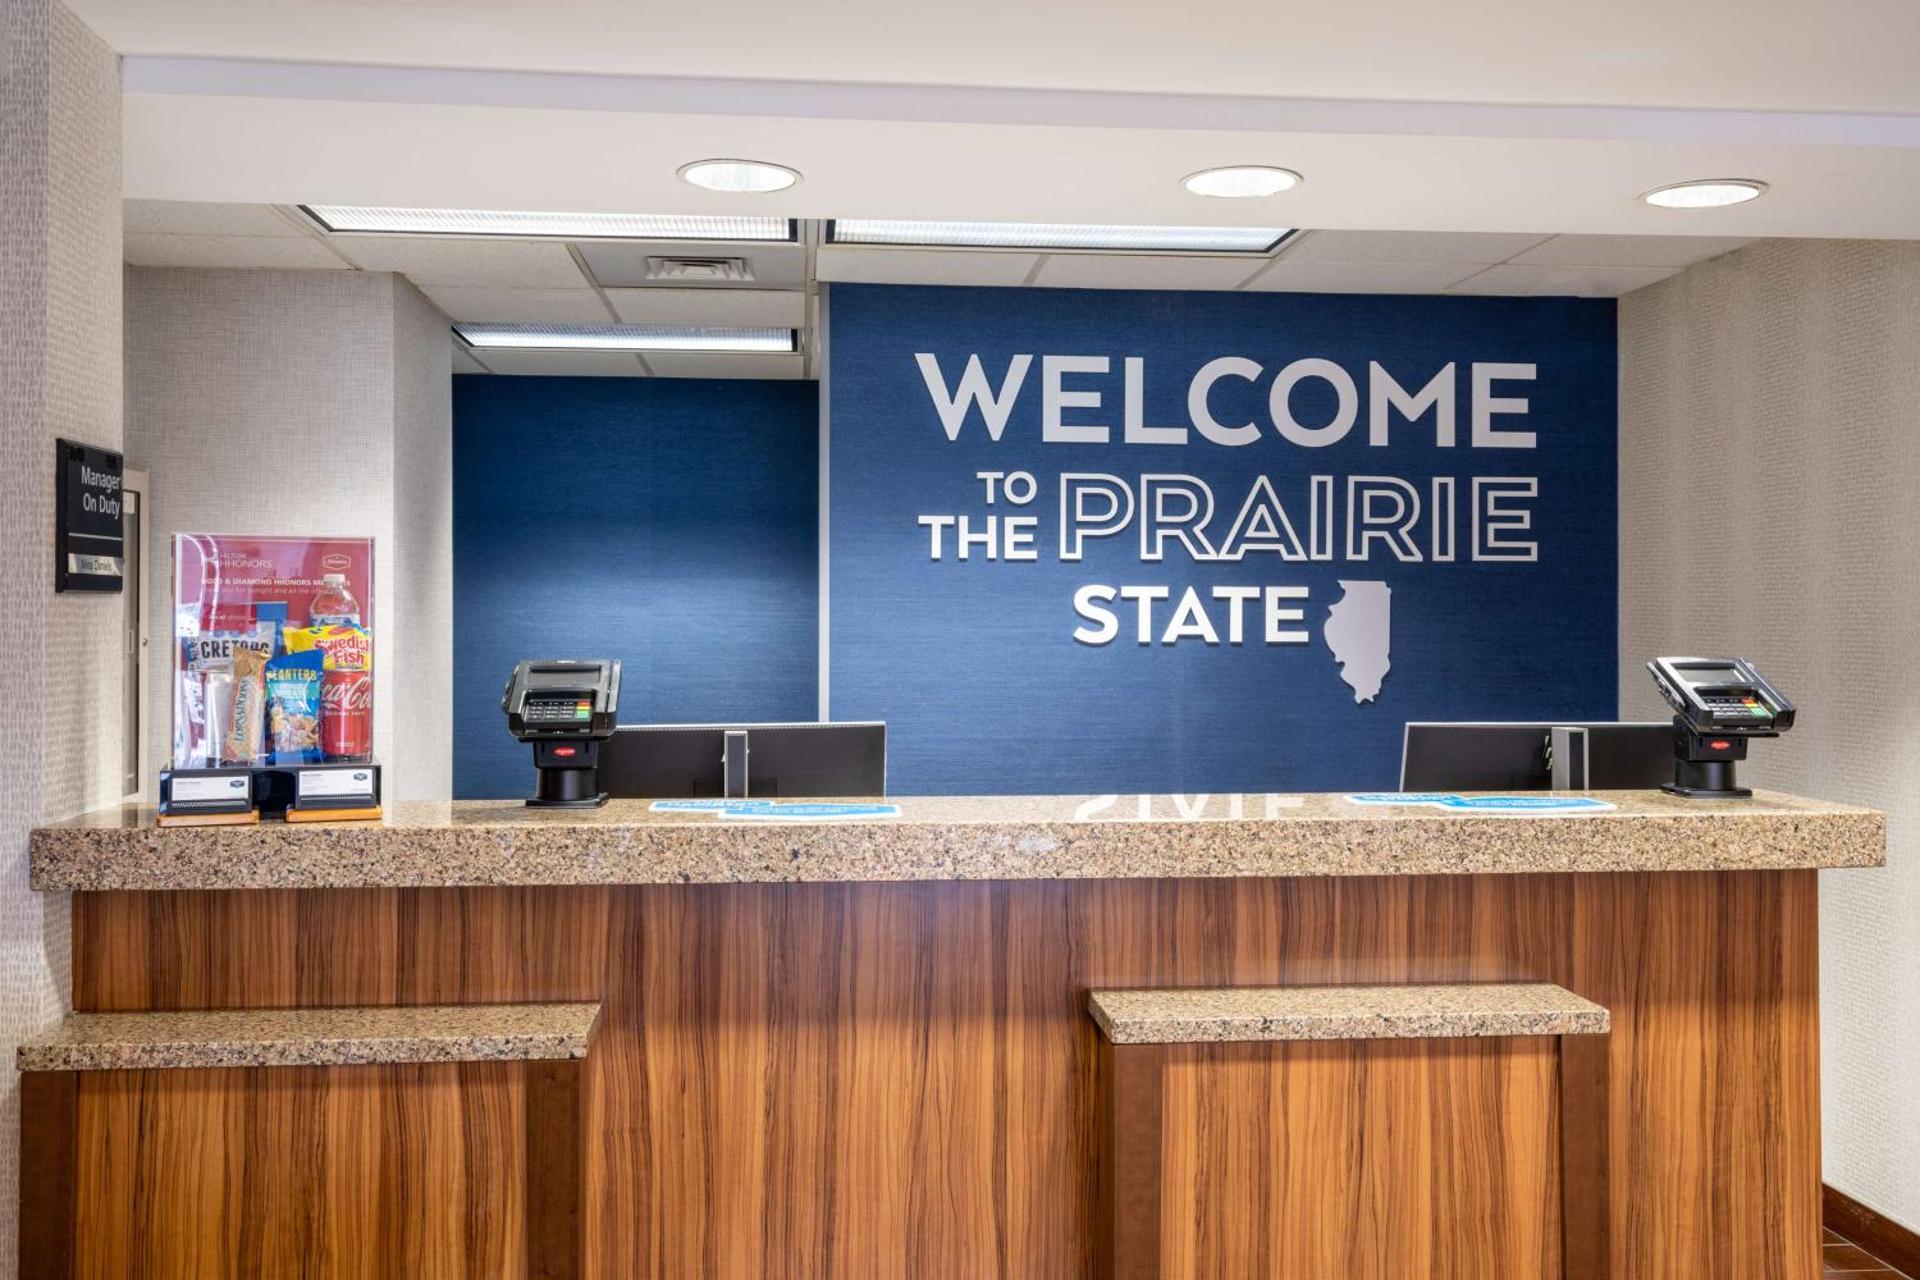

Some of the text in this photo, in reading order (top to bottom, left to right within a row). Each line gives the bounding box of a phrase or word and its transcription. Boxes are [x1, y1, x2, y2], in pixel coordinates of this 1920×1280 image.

[914, 353, 1538, 449] WELCOME
[81, 465, 122, 493] Manager
[976, 471, 1039, 505] TO
[83, 492, 121, 520] On Duty
[918, 472, 1539, 563] THE PRAIRIE
[232, 578, 273, 587] DIAMOND
[1072, 583, 1311, 646] STATE
[333, 649, 365, 667] Fish
